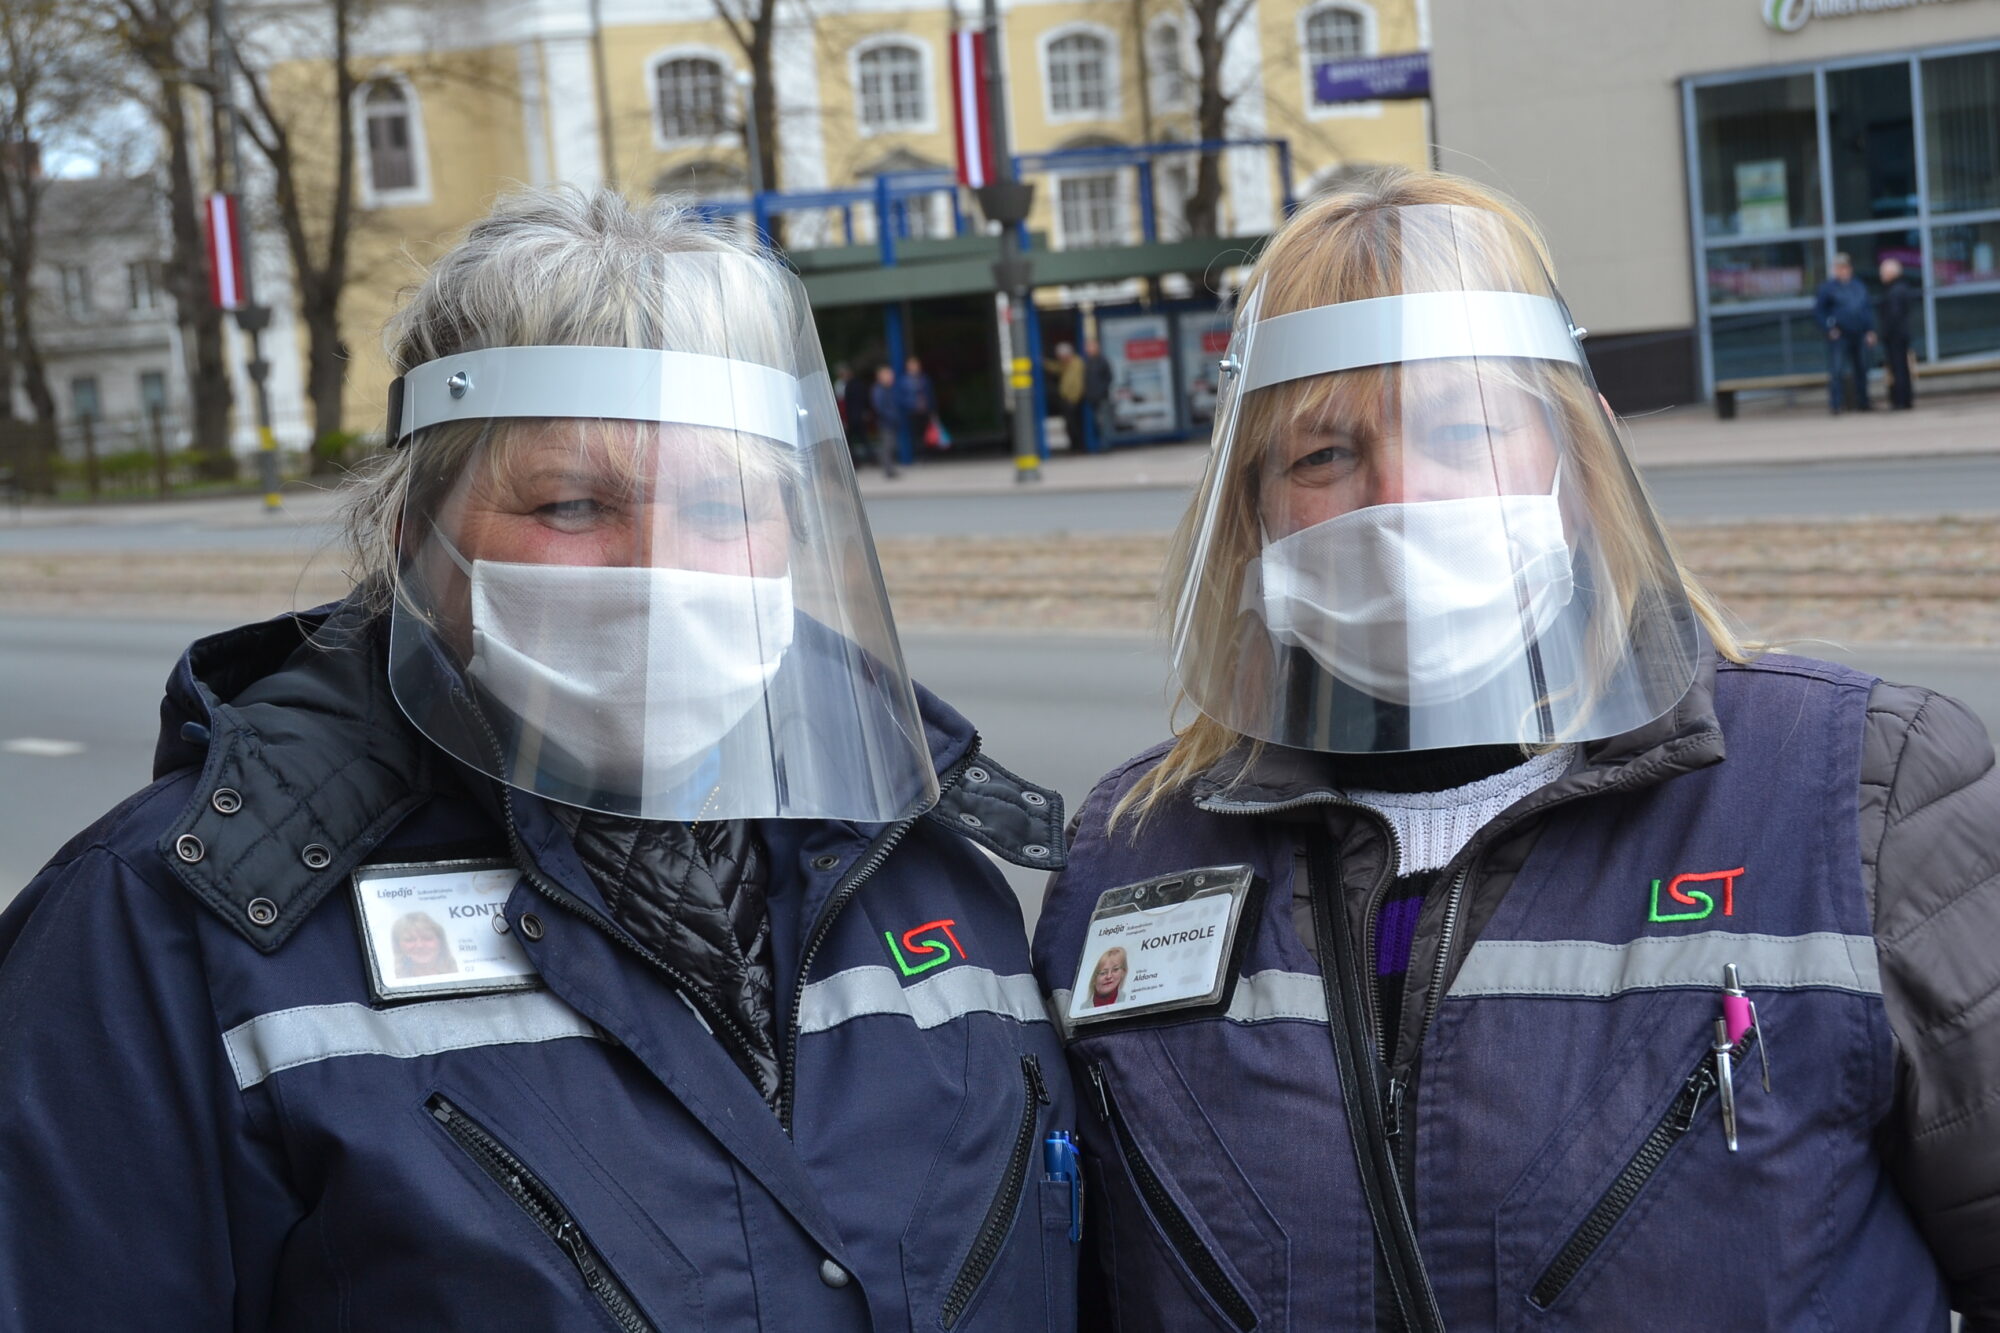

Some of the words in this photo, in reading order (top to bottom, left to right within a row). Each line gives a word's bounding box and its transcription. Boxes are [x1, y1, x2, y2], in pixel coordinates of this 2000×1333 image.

[377, 887, 413, 899] Liepāja
[1647, 867, 1745, 922] LST
[884, 919, 968, 976] LST
[1141, 925, 1215, 951] KONTROLE
